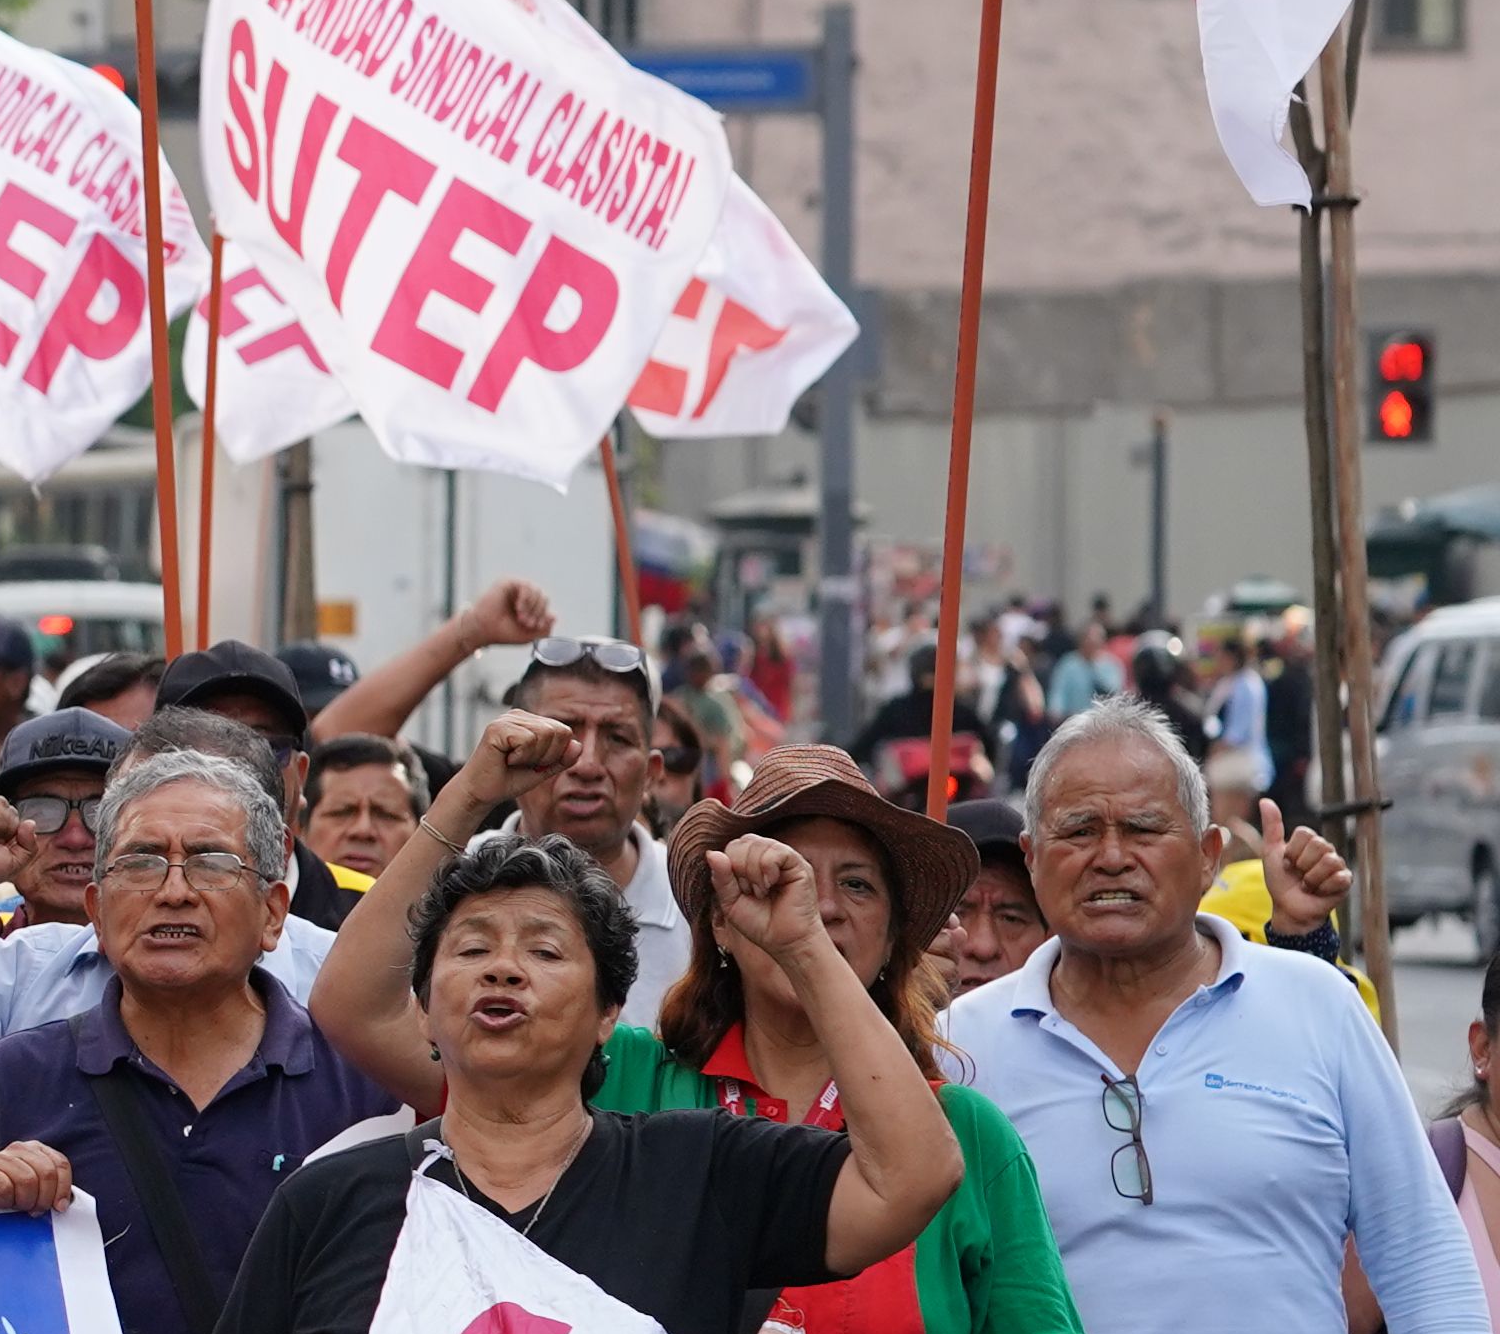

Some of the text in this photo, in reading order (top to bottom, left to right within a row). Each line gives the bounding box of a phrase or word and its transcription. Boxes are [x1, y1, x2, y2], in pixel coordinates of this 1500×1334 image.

[223, 18, 621, 414] SUTEP
[390, 14, 543, 164] SINDICAL
[526, 90, 697, 252] CLASISTA!
